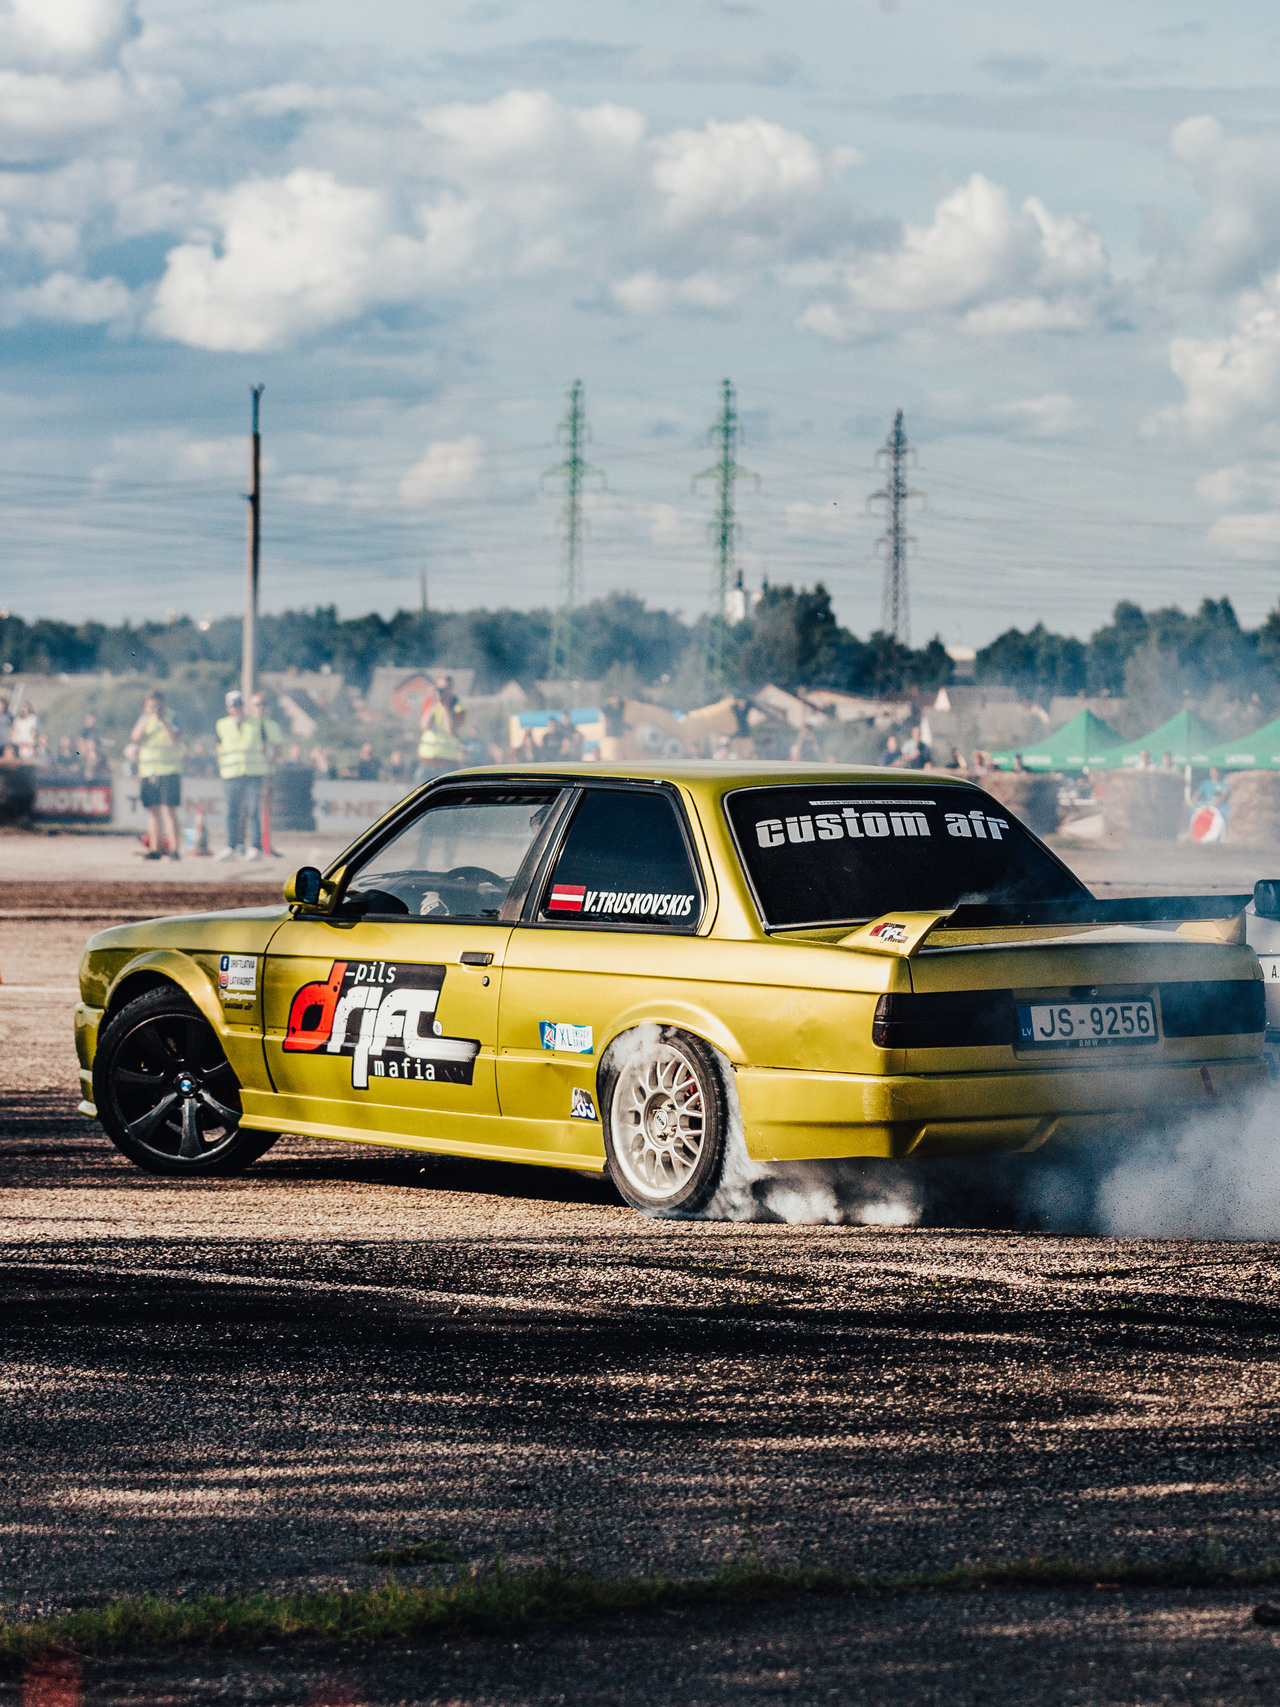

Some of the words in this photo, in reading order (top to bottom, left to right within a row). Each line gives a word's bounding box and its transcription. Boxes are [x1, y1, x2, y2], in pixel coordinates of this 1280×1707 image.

[33, 789, 109, 813] MOTUL
[755, 807, 931, 848] custom
[583, 890, 695, 916] V.TRUSKOVSKIS
[1271, 965, 1280, 979] A.
[1022, 1027, 1032, 1036] LV
[1039, 1005, 1150, 1037] JS-9256
[559, 1028, 573, 1047] XL
[1079, 1039, 1099, 1047] BMW
[373, 1057, 436, 1081] mafia
